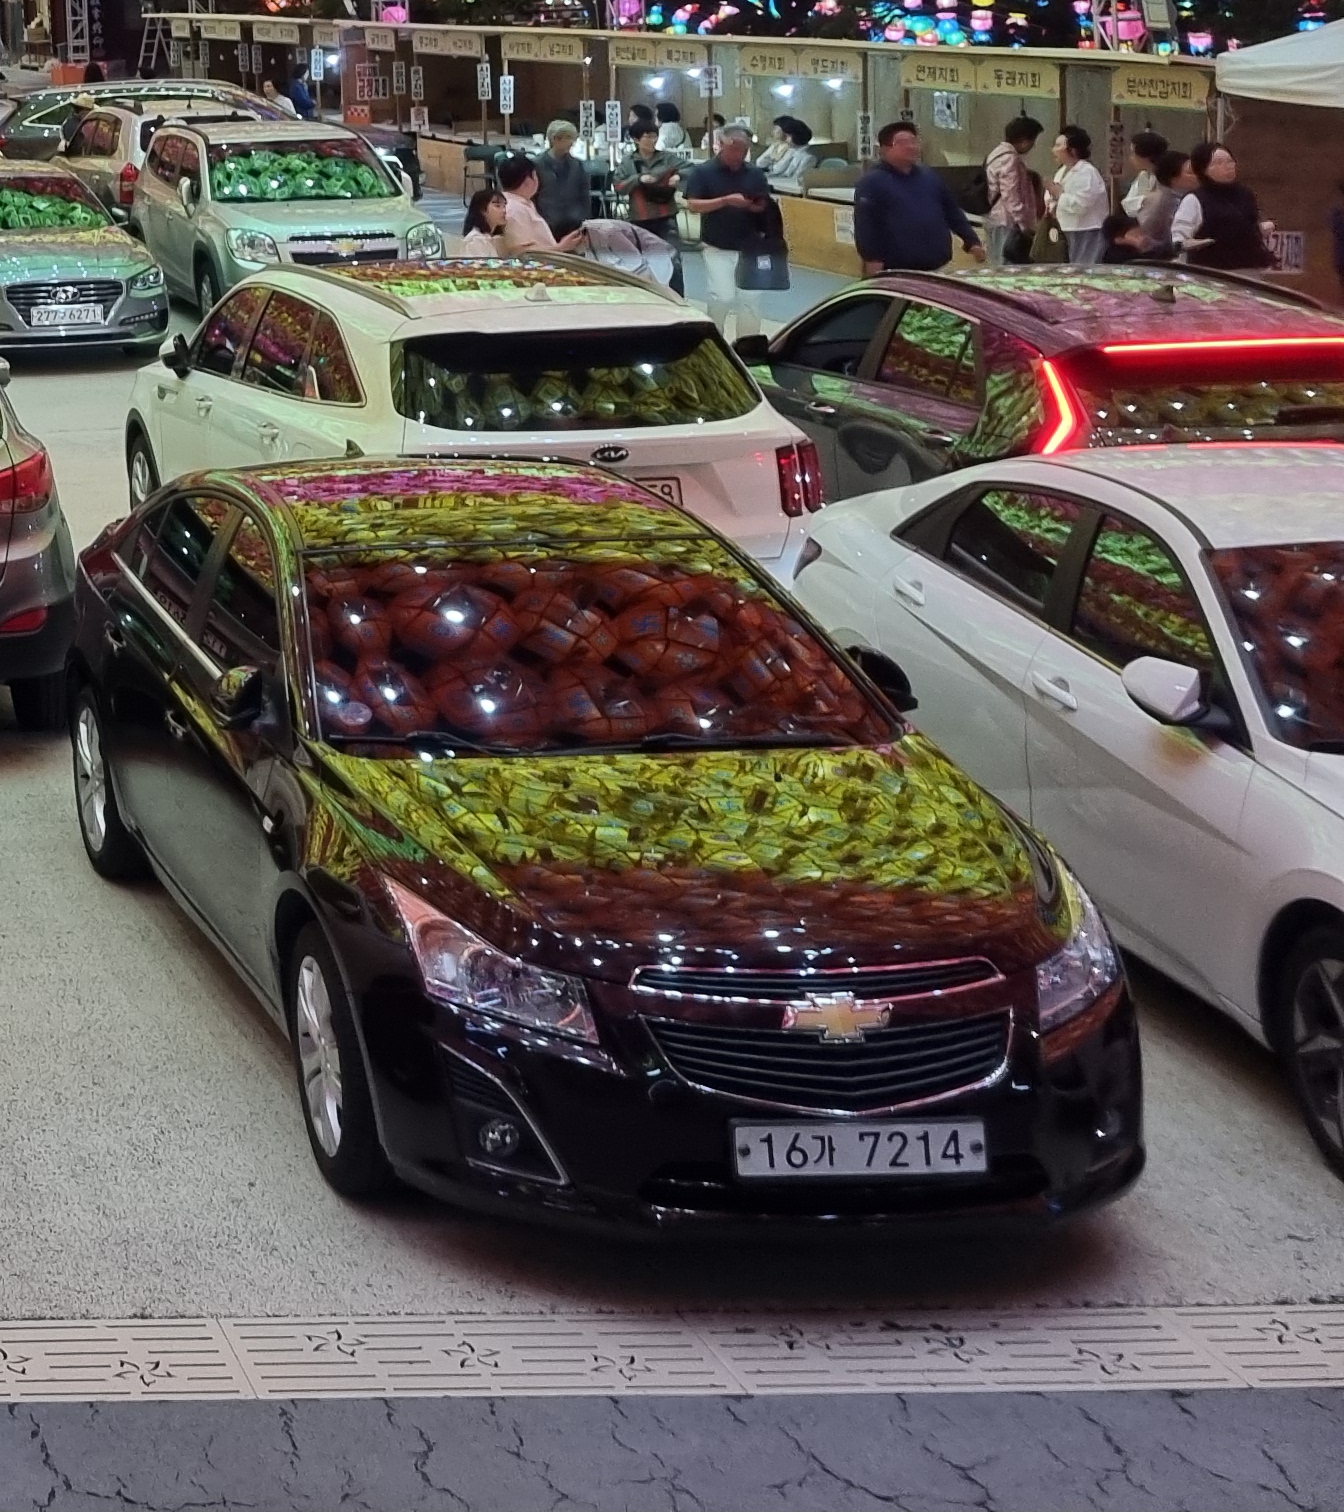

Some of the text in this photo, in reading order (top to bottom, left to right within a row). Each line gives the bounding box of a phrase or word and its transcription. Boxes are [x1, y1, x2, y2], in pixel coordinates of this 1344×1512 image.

[915, 63, 959, 84] 연제지회
[993, 67, 1041, 89] 동래지회
[1126, 76, 1193, 100] 부산진갑지회
[68, 308, 97, 321] 6271
[759, 1128, 965, 1170] 16가 7214
